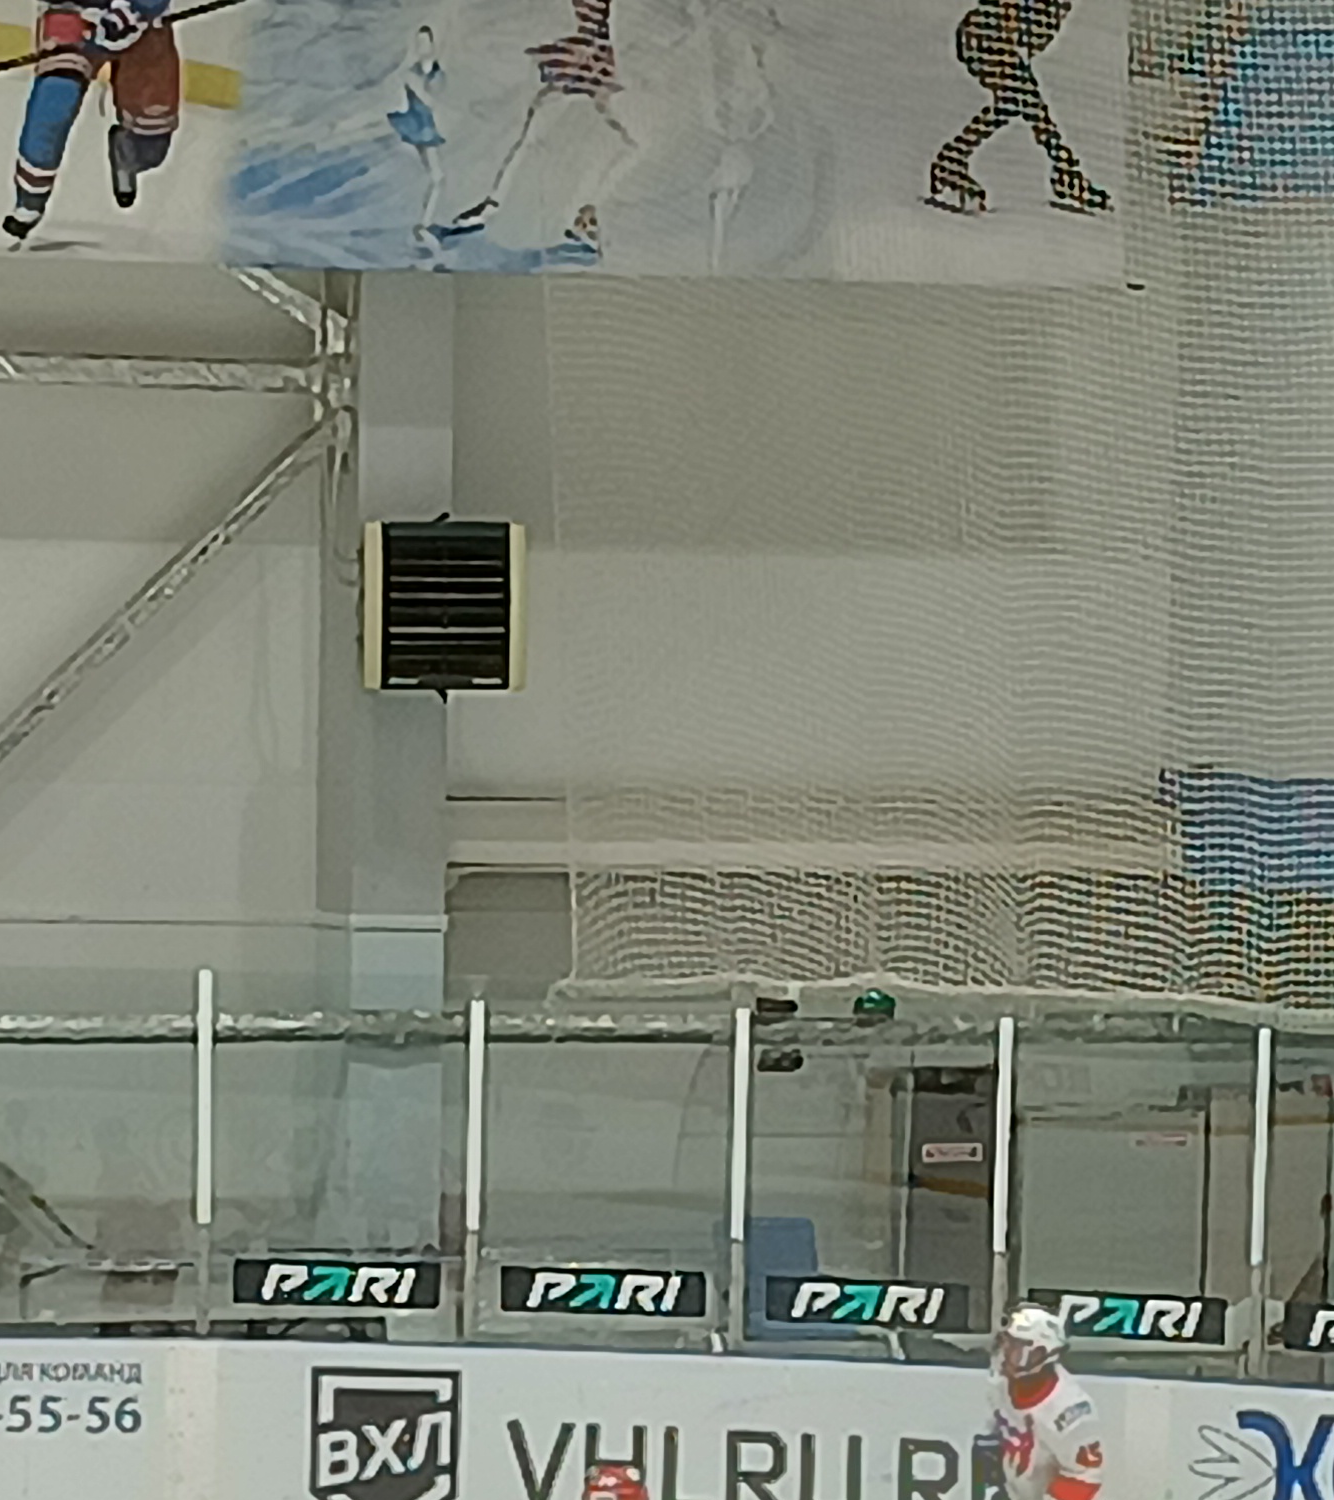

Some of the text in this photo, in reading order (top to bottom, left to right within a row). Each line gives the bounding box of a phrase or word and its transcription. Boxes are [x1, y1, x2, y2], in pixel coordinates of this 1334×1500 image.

[261, 1263, 415, 1304] PARI
[526, 1270, 681, 1314] PARI
[791, 1281, 945, 1325] PARI
[1058, 1295, 1201, 1338] PARI
[38, 1361, 142, 1385] КОМАНД
[317, 1410, 452, 1488] ВХЛ
